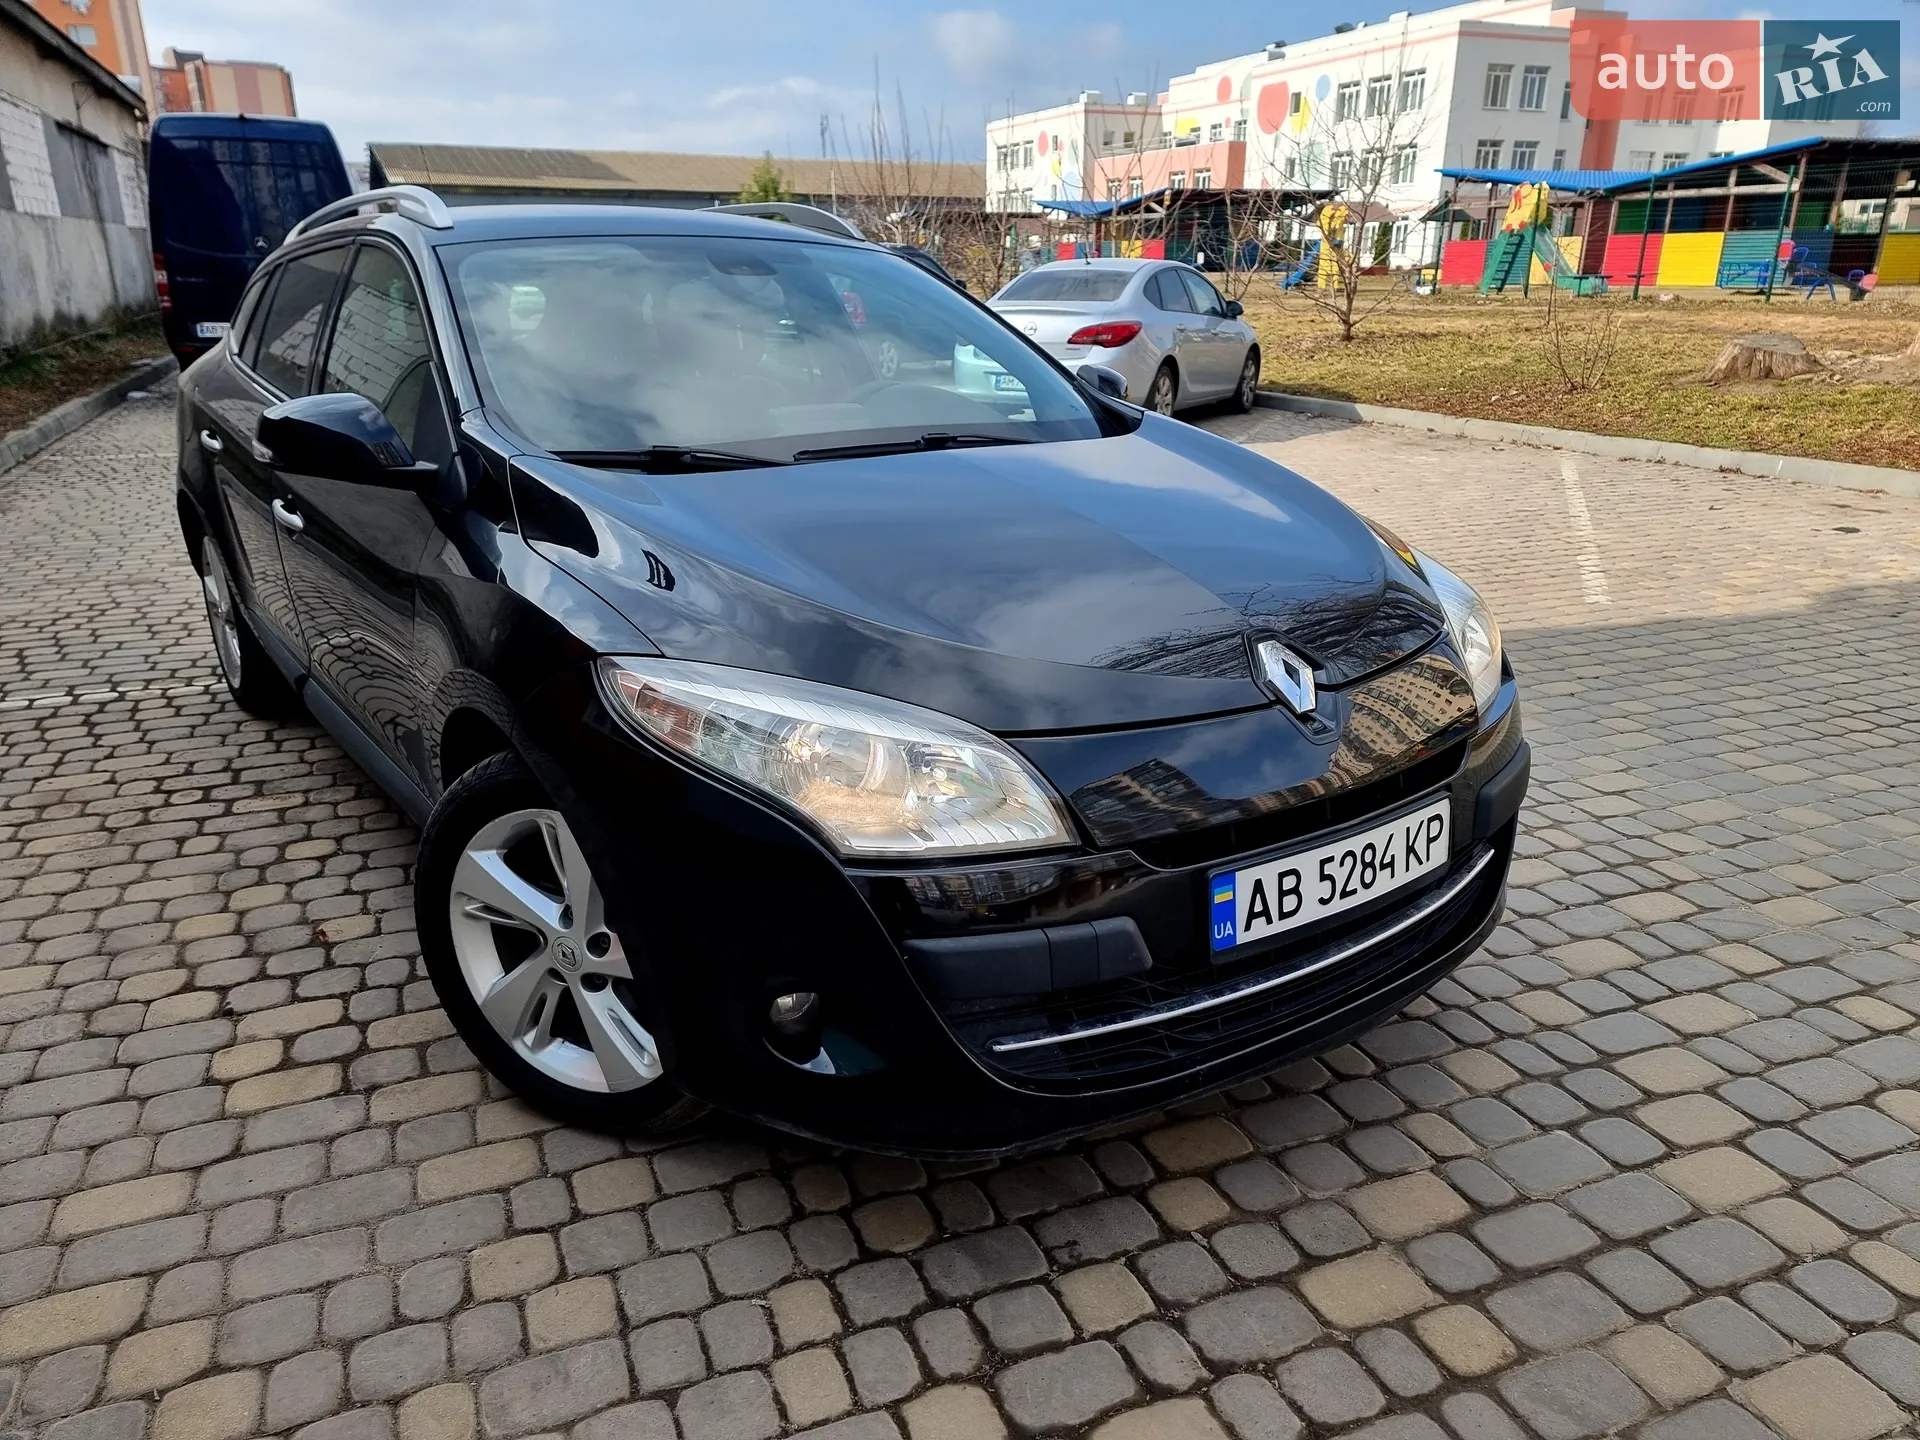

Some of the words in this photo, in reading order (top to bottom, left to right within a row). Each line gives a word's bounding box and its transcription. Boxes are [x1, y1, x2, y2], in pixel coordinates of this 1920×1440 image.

[1243, 867, 1303, 933] AB
[1317, 832, 1396, 906] 5284
[1405, 812, 1445, 874] KP
[1214, 921, 1234, 939] UA
